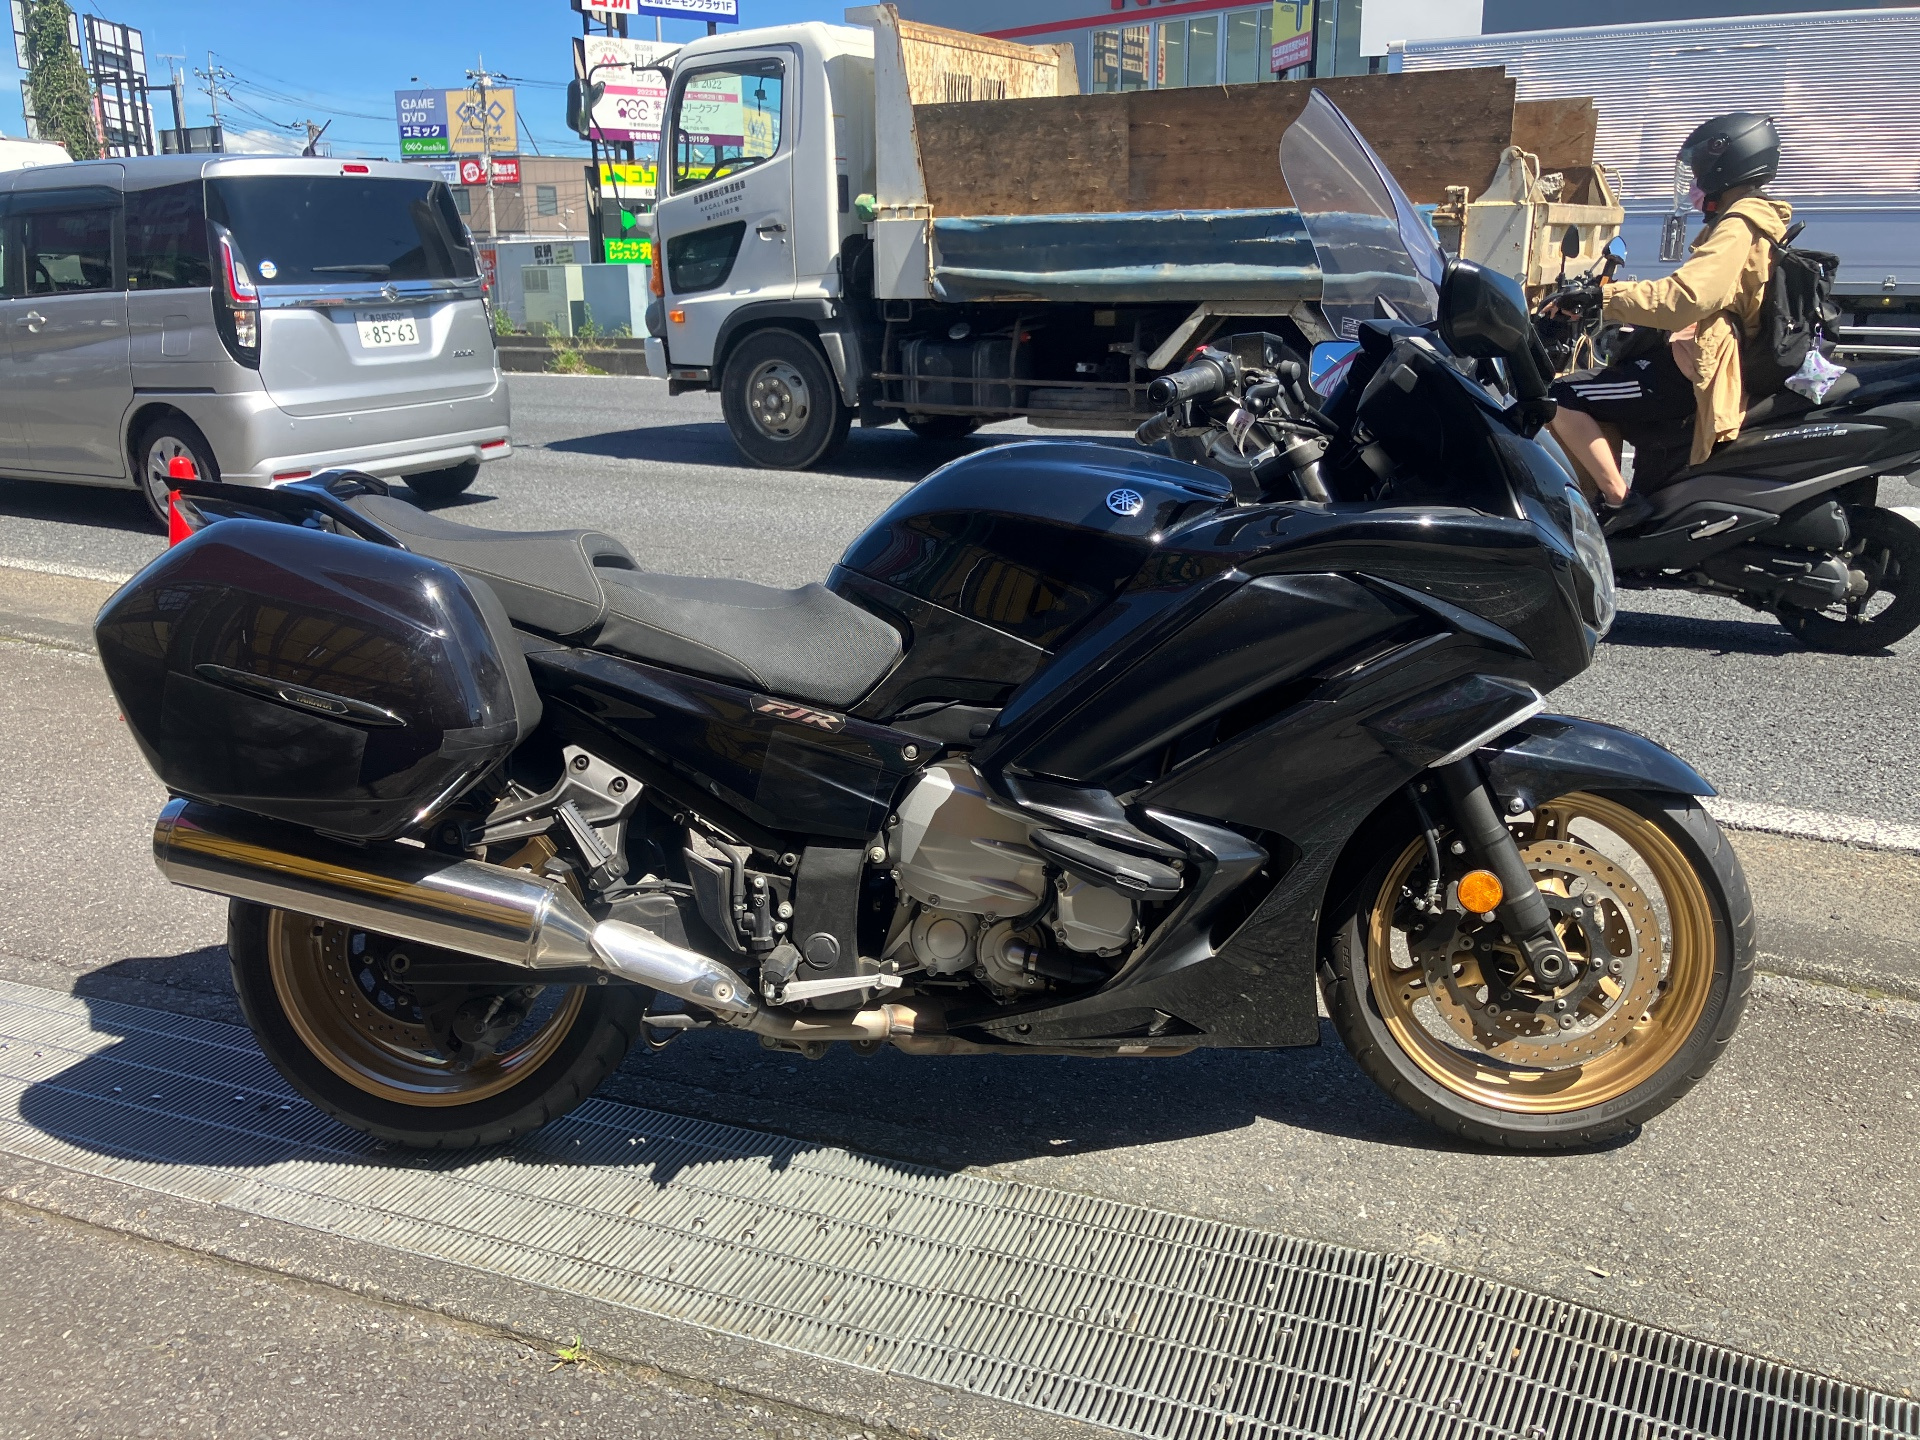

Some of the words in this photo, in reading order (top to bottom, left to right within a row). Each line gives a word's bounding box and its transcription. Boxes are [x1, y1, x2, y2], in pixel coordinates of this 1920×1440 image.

[701, 80, 722, 89] 2022
[401, 98, 435, 109] GAME
[402, 112, 426, 122] DVD
[402, 125, 440, 137] コミック
[422, 142, 446, 151] mobile
[609, 242, 639, 250] スクール
[609, 251, 639, 260] レッスン
[372, 323, 415, 344] 85-63
[756, 699, 840, 730] FJR
